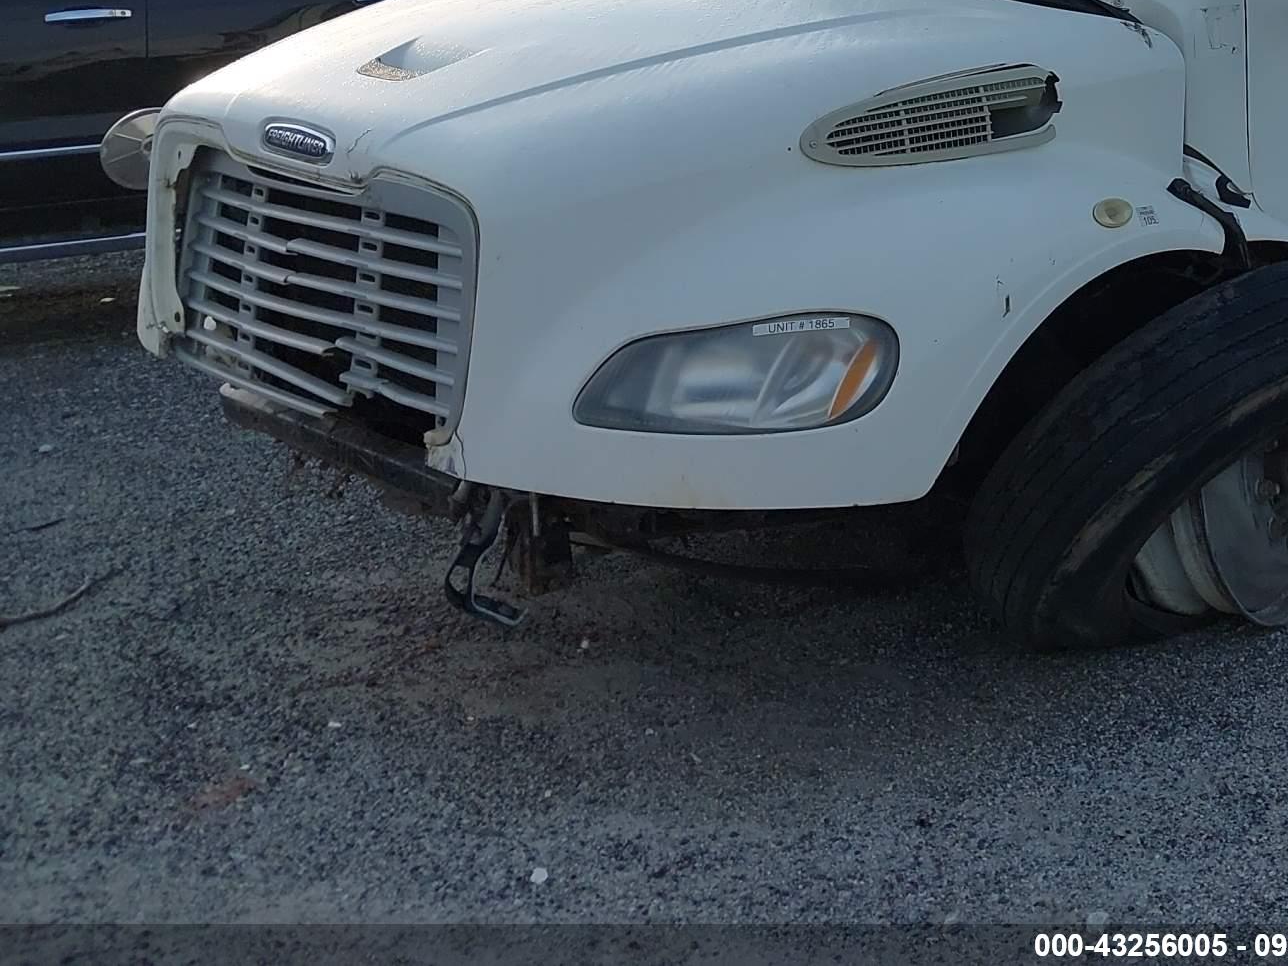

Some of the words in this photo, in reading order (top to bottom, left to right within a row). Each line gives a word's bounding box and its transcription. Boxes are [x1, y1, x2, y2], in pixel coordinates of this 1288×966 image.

[267, 128, 325, 155] FREIGHTLINER
[768, 321, 796, 333] UNIT
[799, 321, 805, 330] #
[809, 318, 835, 330] 1865
